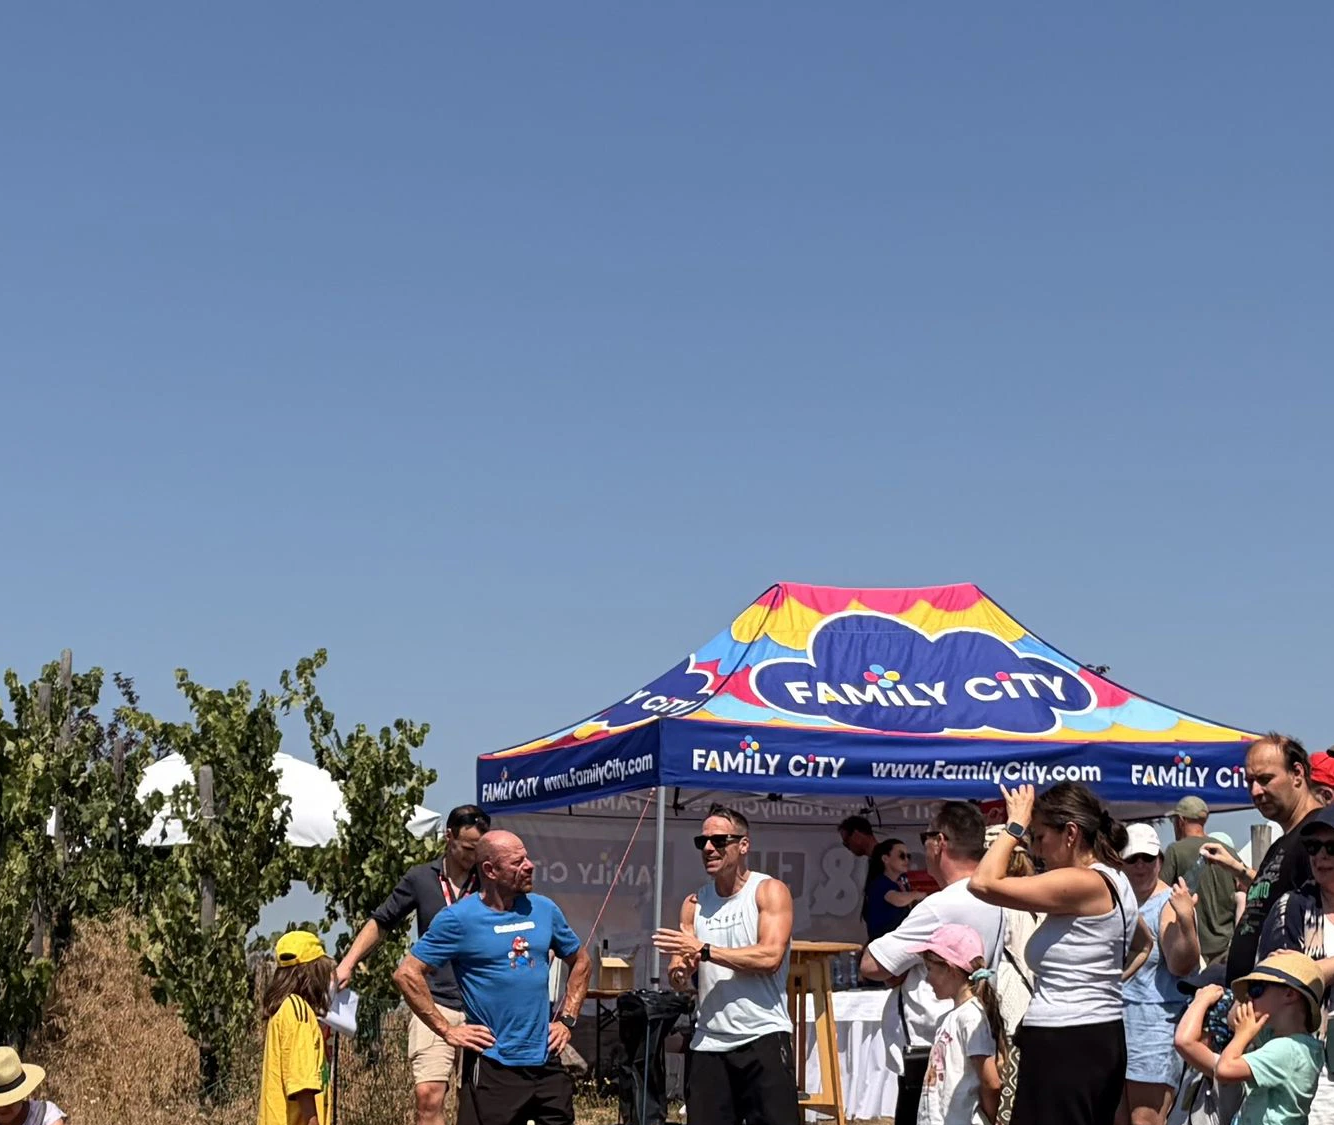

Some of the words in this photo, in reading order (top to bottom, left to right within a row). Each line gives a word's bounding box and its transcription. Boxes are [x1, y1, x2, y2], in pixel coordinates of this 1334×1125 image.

[544, 753, 653, 791] www.FamilyCity.com
[871, 759, 1101, 786] www.FamilyCity.com
[1216, 766, 1249, 788] CiT
